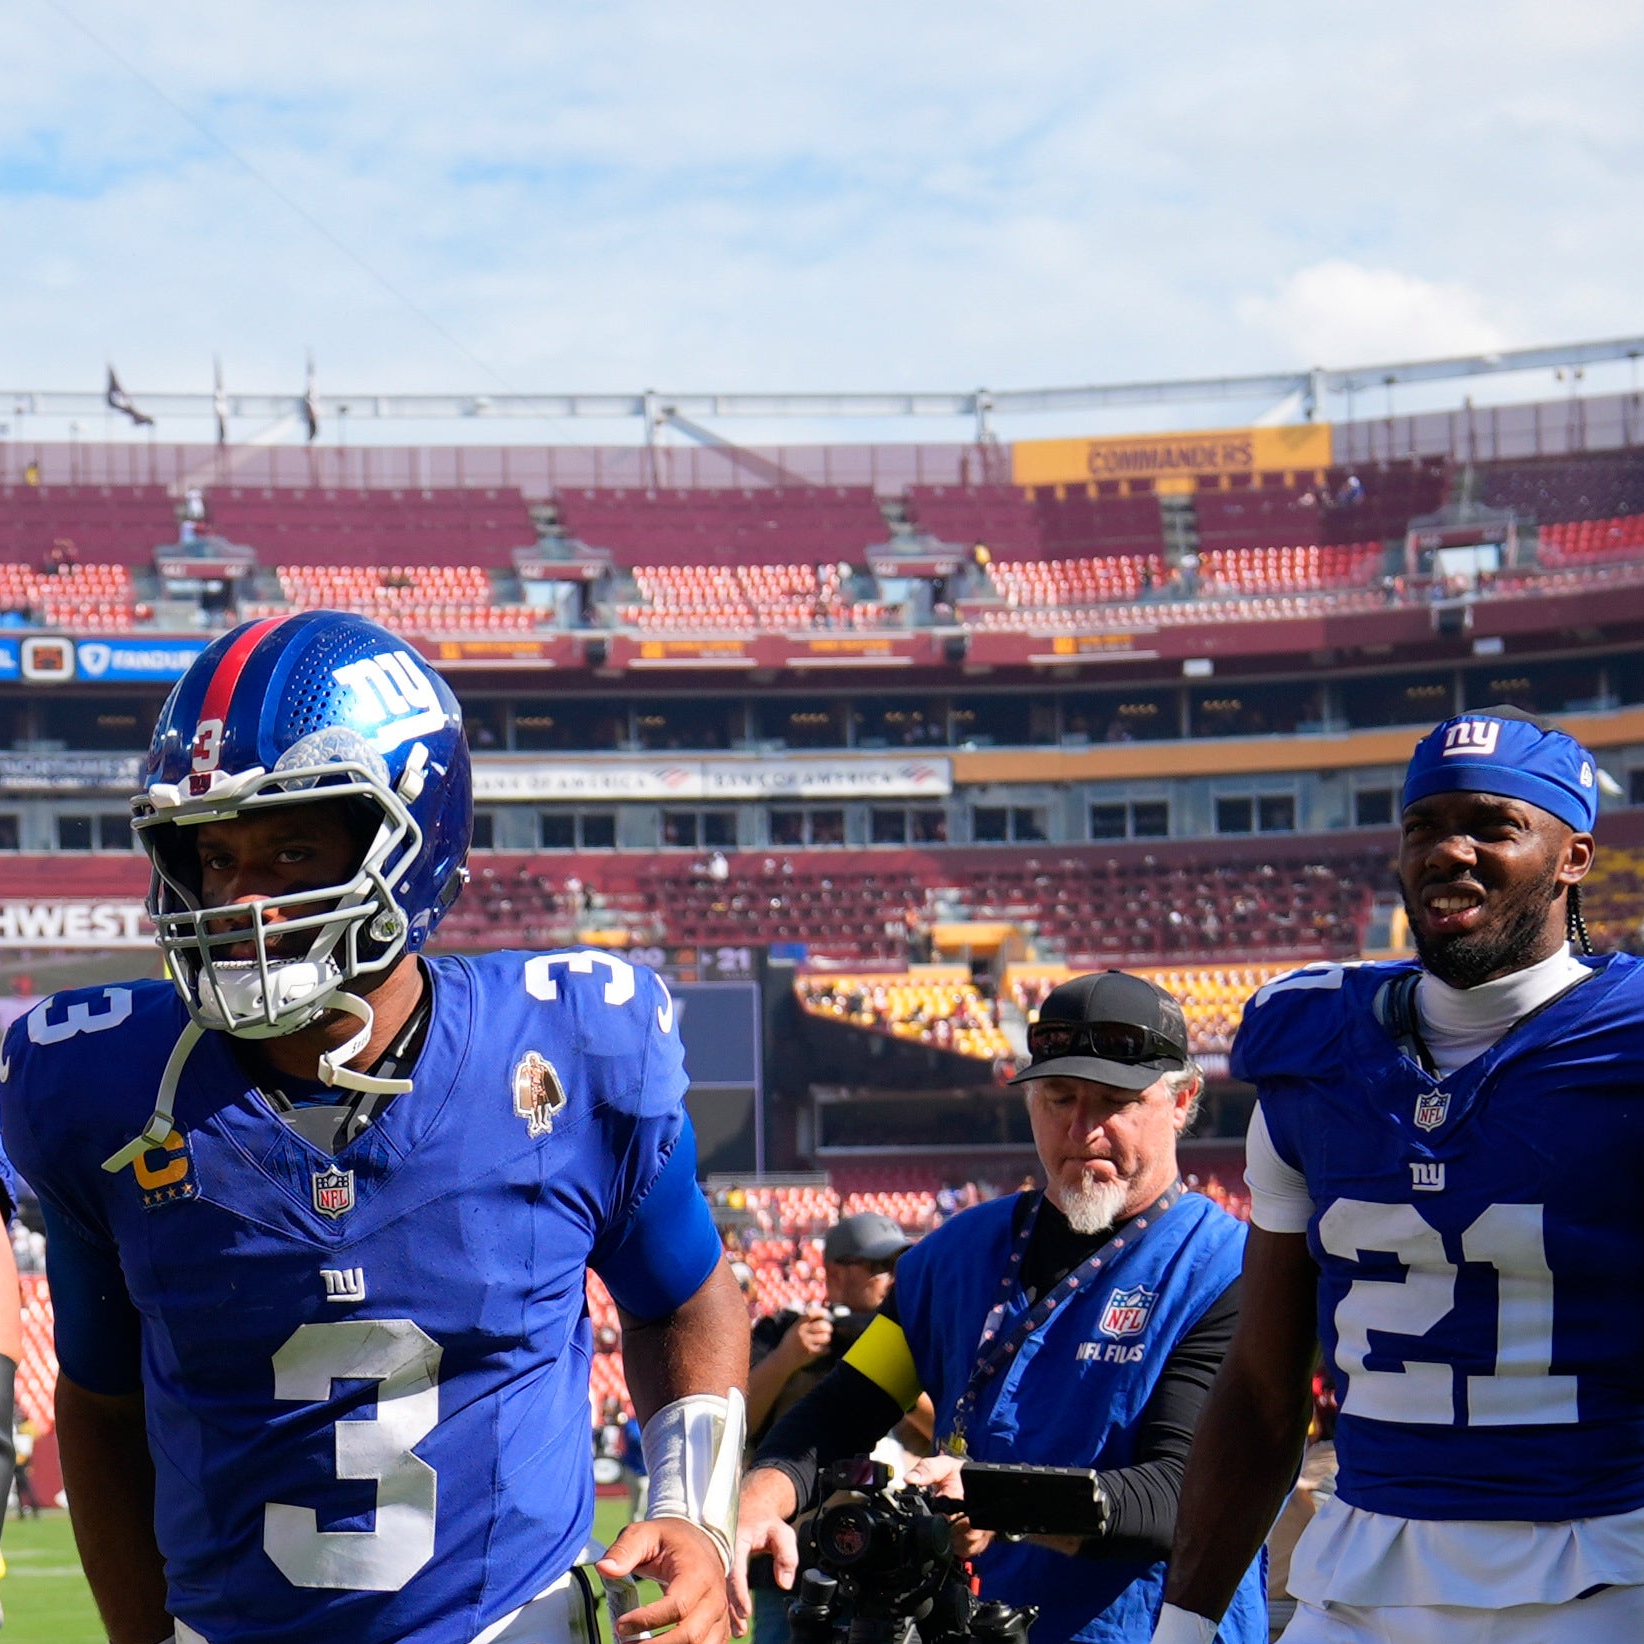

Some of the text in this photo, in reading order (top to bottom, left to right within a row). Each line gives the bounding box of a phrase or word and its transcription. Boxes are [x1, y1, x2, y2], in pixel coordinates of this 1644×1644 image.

[1089, 440, 1252, 475] COMMANDERS
[192, 718, 224, 773] 3
[557, 773, 645, 791] AMERICA
[714, 772, 767, 788] BANK
[801, 770, 893, 787] AMERICA
[716, 947, 752, 972] 21
[525, 950, 635, 1007] 3
[27, 985, 133, 1047] 3
[1420, 1107, 1442, 1124] NFL
[320, 1189, 348, 1209] NFL
[1106, 1308, 1142, 1331] NFL
[1317, 1198, 1582, 1427] 21
[1075, 1341, 1102, 1361] NFL
[262, 1319, 444, 1591] 3
